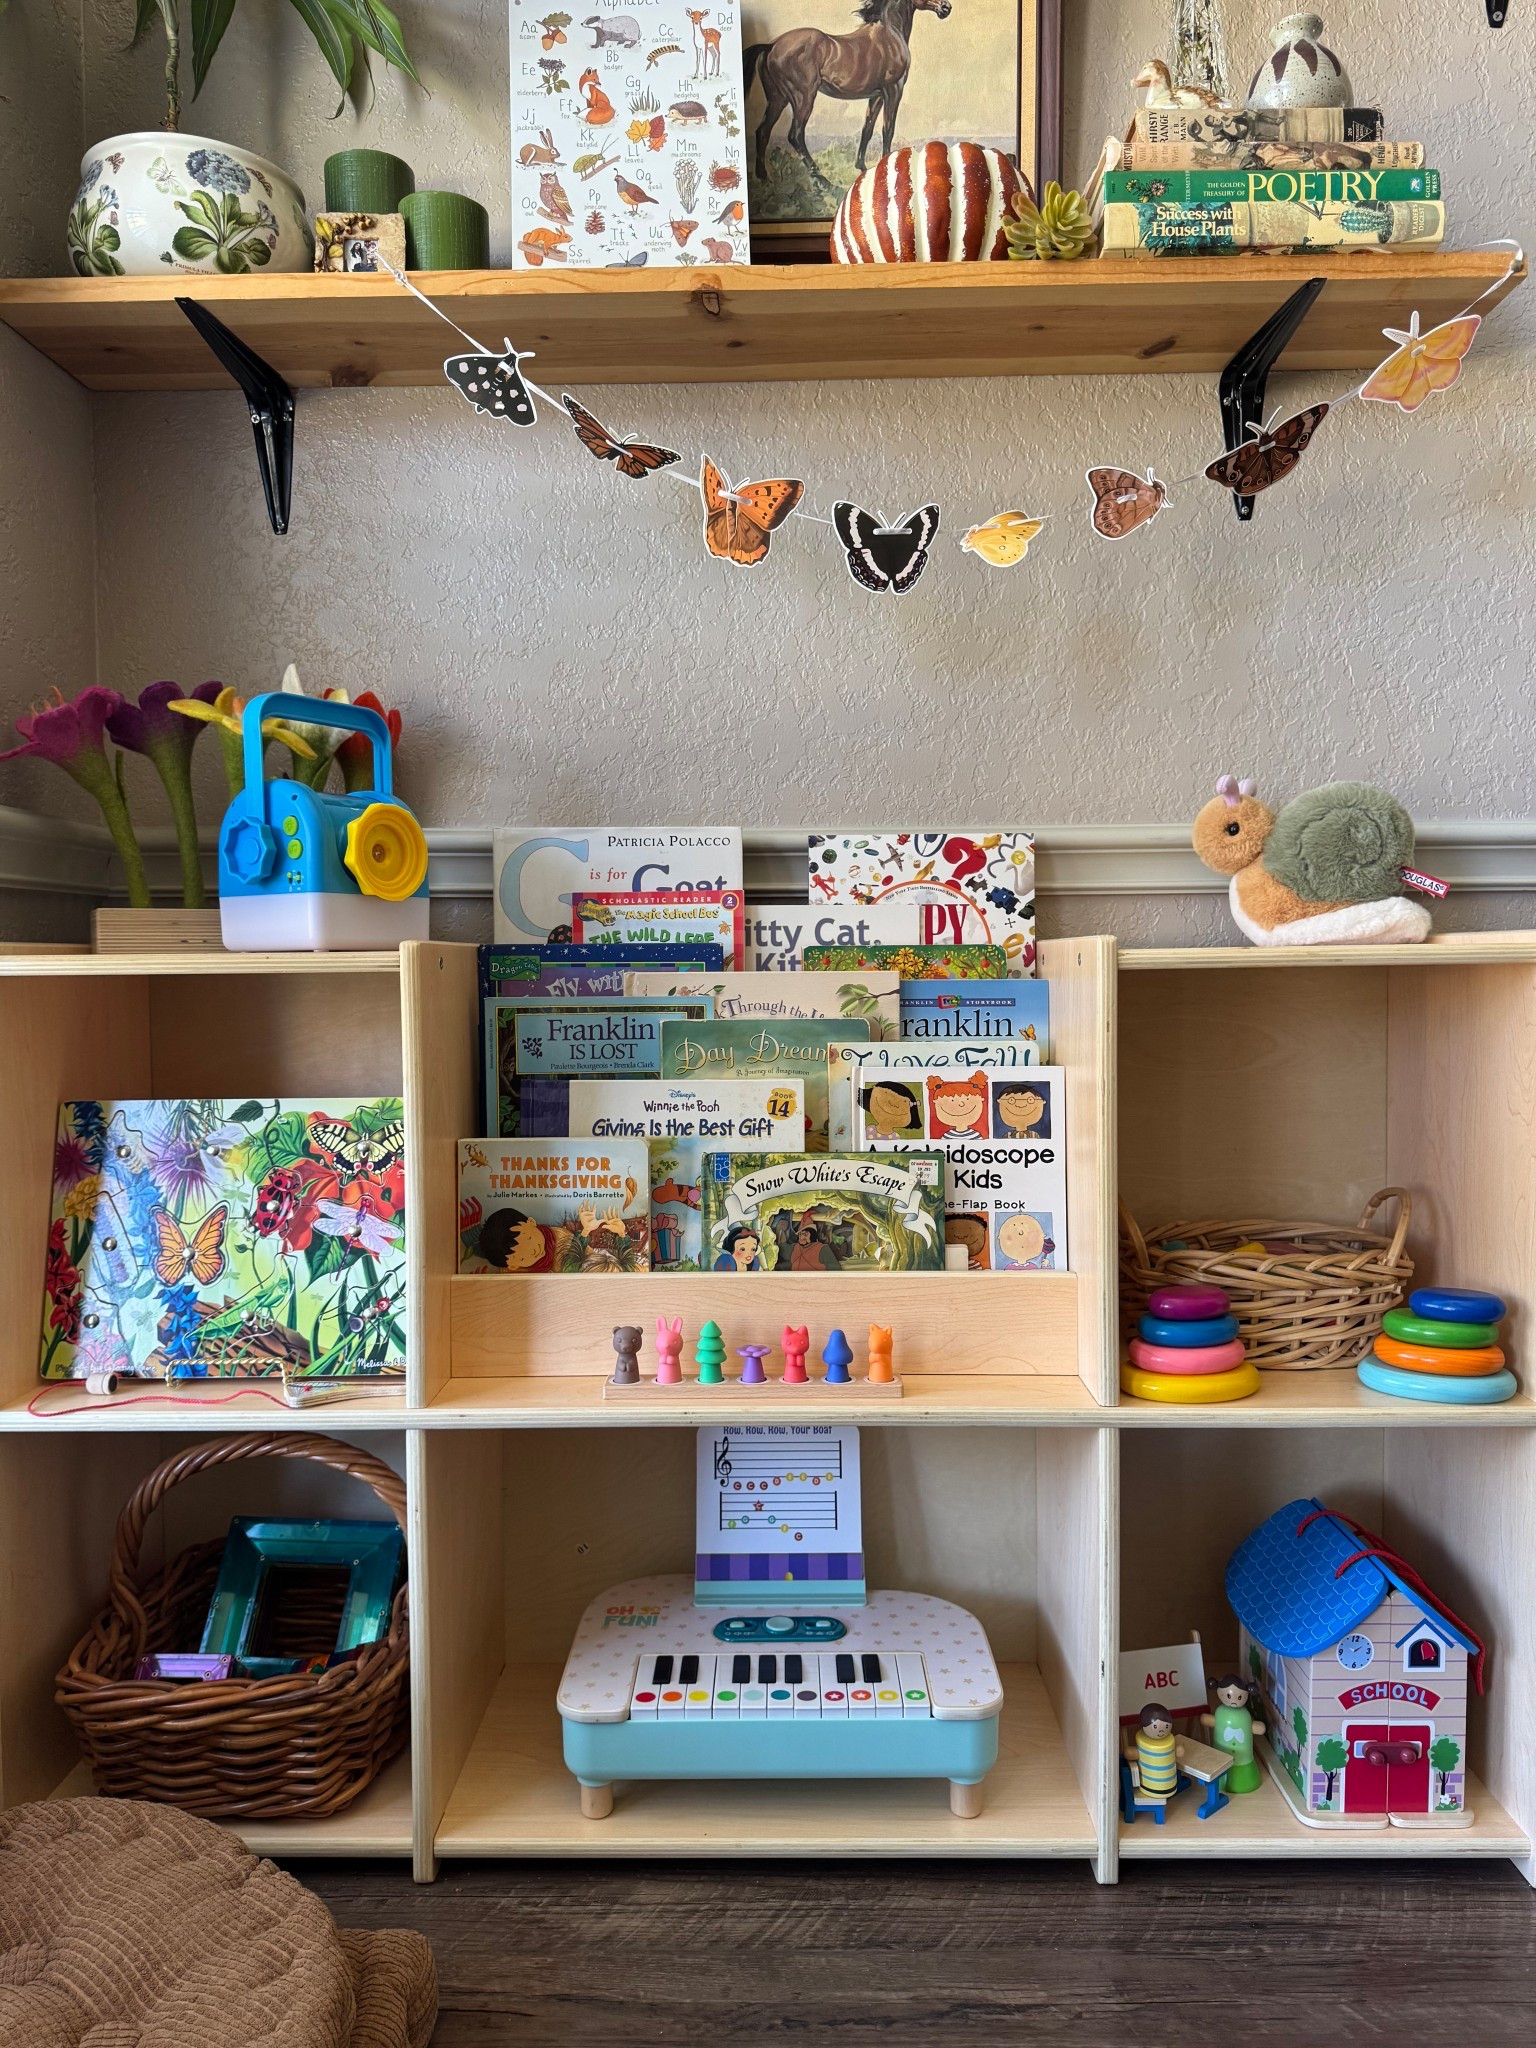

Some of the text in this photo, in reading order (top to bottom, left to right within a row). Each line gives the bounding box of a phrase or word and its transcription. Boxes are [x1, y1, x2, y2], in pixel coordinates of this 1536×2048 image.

[717, 12, 733, 25] Dd
[521, 20, 538, 33] Aa
[658, 24, 674, 37] Cc
[652, 35, 682, 43] caterpillar
[606, 49, 619, 63] Bb
[522, 63, 536, 76] Ee
[625, 75, 641, 91] Gg
[678, 80, 693, 92] Hh
[517, 89, 546, 98] elderberry
[559, 99, 573, 111] Ff
[522, 108, 535, 125] Jj
[516, 124, 544, 132] jackrabbit
[1149, 111, 1157, 143] HIRSTY
[580, 128, 594, 141] Kk
[577, 141, 598, 149] katydid
[628, 144, 639, 157] Ll
[676, 139, 697, 151] Mm
[725, 145, 740, 158] Nn
[636, 168, 652, 184] Qq
[1247, 171, 1386, 201] POETRY
[521, 196, 537, 209] Oo
[589, 188, 601, 204] Pp
[708, 196, 720, 209] Rr
[1156, 207, 1241, 220] Success with
[610, 228, 624, 241] Tt
[649, 226, 663, 238] Uu
[1151, 221, 1247, 237] House Plants
[568, 244, 583, 257] Ss
[733, 239, 748, 251] Vv
[607, 835, 731, 847] PATRICIA POLACCO
[589, 867, 601, 880] is
[606, 867, 628, 882] for
[726, 896, 733, 904] 2
[625, 908, 662, 922] Magic
[662, 908, 698, 920] School
[698, 907, 719, 919] Bus
[921, 904, 970, 945] PY
[588, 930, 622, 944] THE
[627, 927, 671, 943] WILD
[744, 918, 803, 953] itty
[491, 962, 522, 974] Dragon
[721, 994, 787, 1017] Through
[789, 1004, 808, 1018] the
[546, 1016, 656, 1041] Franklin
[901, 1009, 1014, 1038] ranklin
[569, 1043, 638, 1060] IS LOST
[674, 1037, 734, 1075] Day
[550, 1061, 655, 1071] Paulette Bourgeois Brenda Clark
[744, 1068, 767, 1077] Journey
[776, 1067, 810, 1076] Imagination
[668, 1089, 696, 1100] Disney's
[774, 1091, 793, 1099] BOOK
[643, 1099, 720, 1113] Winnie the Pooh
[768, 1099, 790, 1118] 14
[591, 1118, 775, 1137] Giving Is the Best Gift
[500, 1156, 611, 1171] THANKS FOR
[489, 1174, 622, 1189] THANKSGIVING
[745, 1162, 906, 1197] Snow White's Escape
[954, 1169, 1003, 1189] Kids
[994, 1199, 1026, 1209] Book
[356, 1357, 391, 1369] Melissa
[790, 1426, 810, 1434] Your
[812, 1426, 832, 1434] Boat
[607, 1606, 635, 1616] OH
[603, 1615, 658, 1628] FUN!
[1351, 1635, 1360, 1643] 12
[1338, 1648, 1344, 1656] 9
[1365, 1647, 1371, 1655] 3
[1351, 1661, 1357, 1669] 6
[1144, 1670, 1180, 1690] ABC
[1350, 1683, 1430, 1705] SCHOOL
